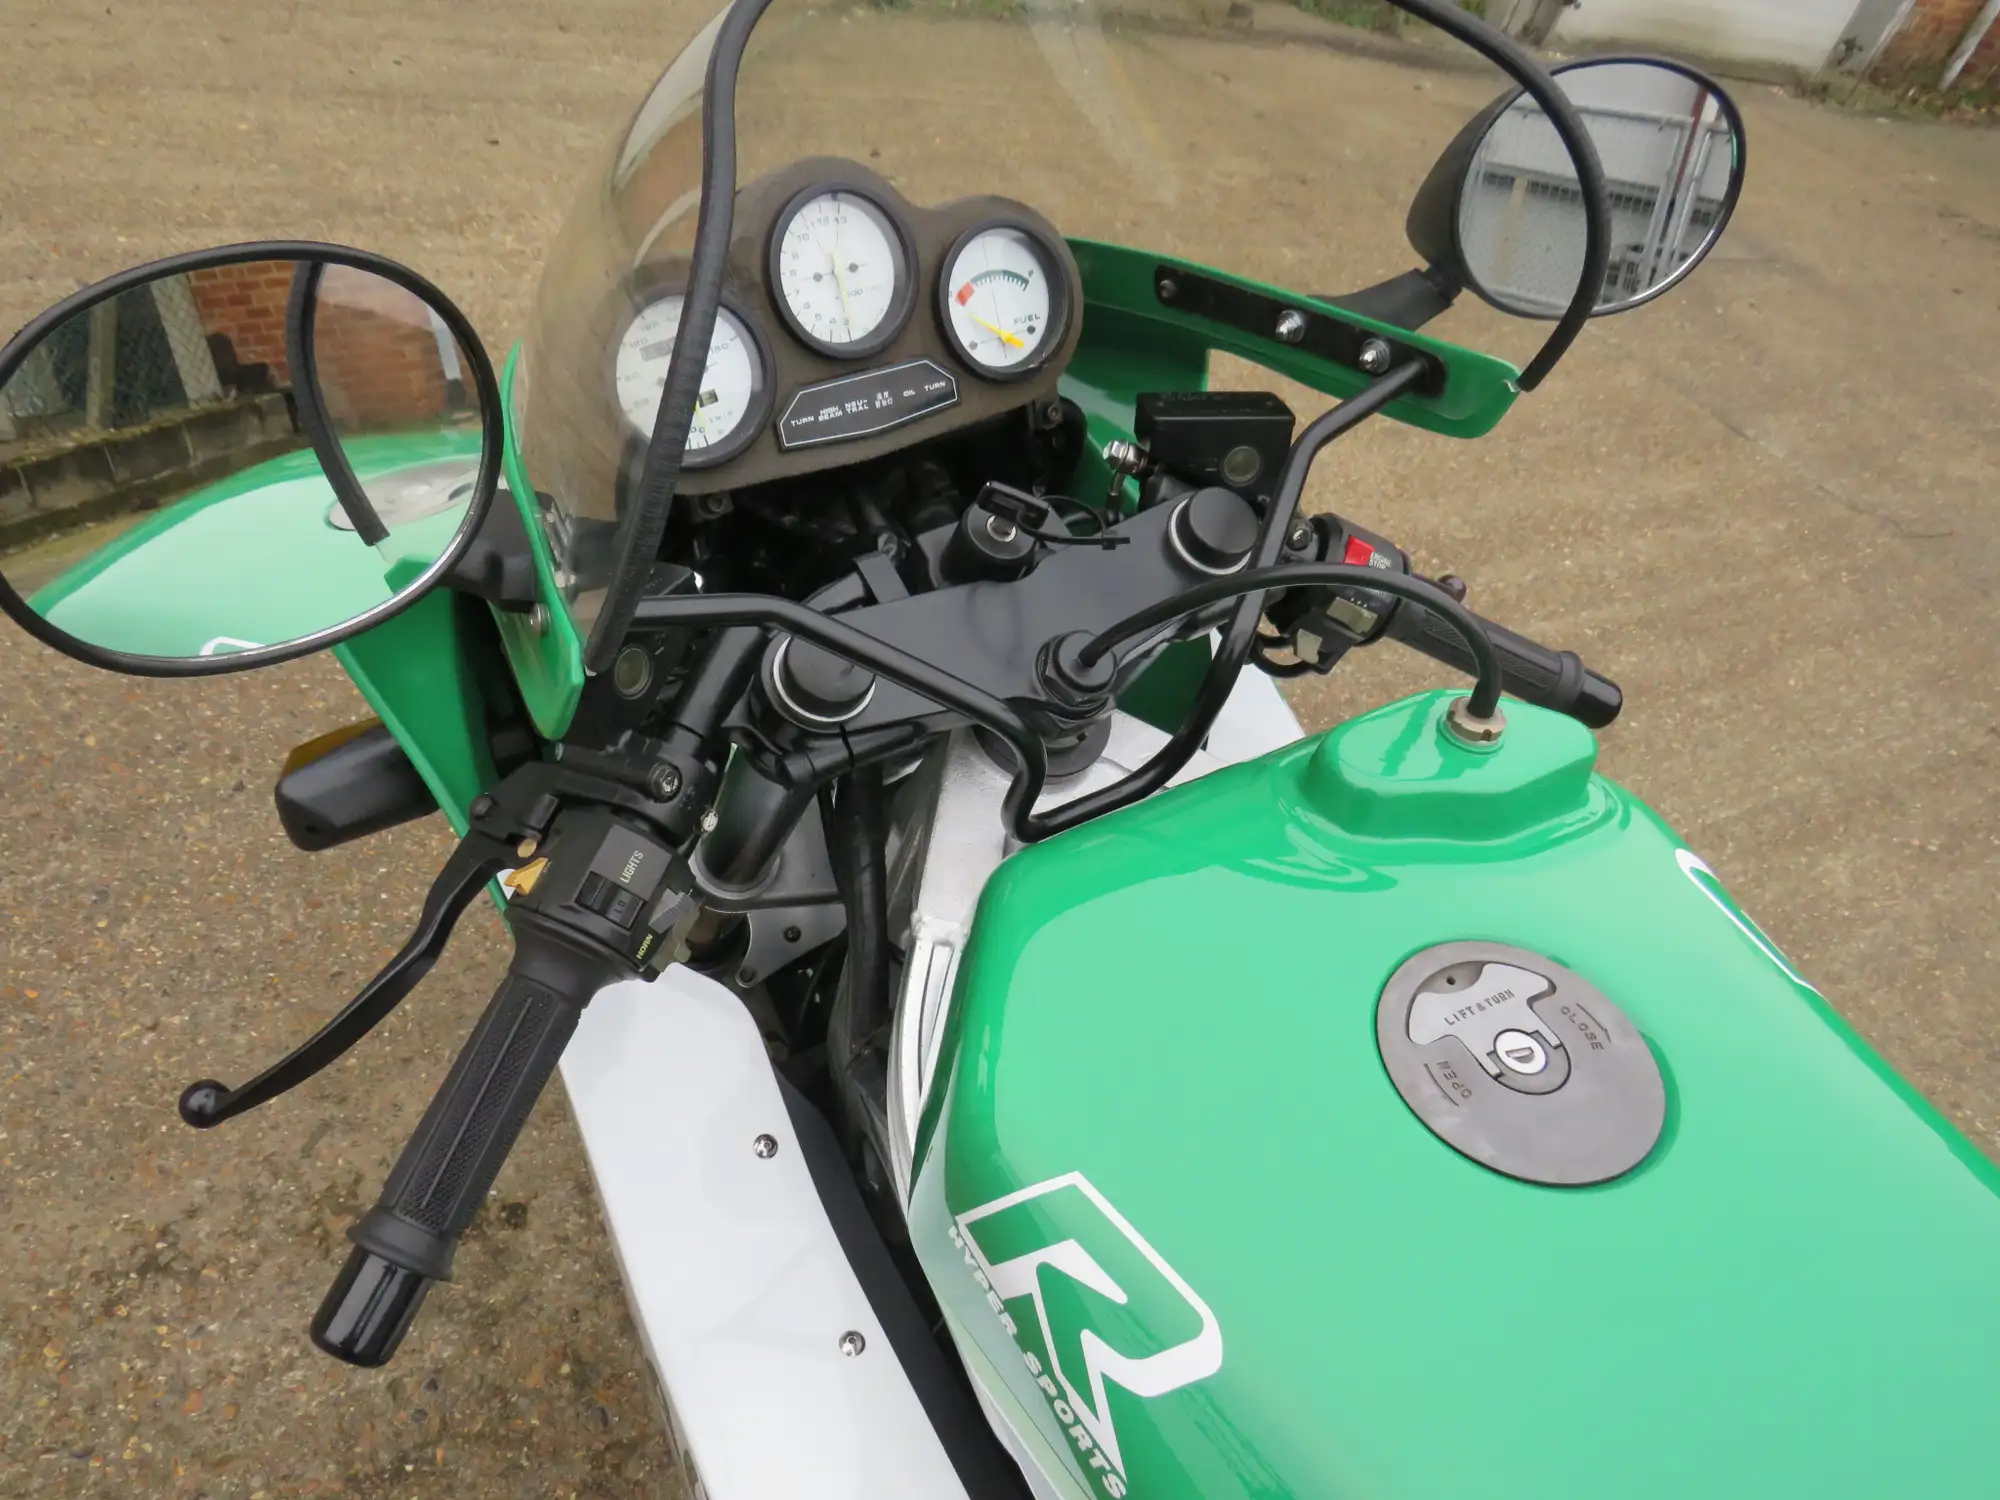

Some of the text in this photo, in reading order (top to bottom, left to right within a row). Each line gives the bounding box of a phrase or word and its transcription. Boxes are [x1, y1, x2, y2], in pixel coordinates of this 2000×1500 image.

[1013, 313, 1040, 325] FUEL
[903, 389, 915, 397] OIL
[924, 381, 946, 392] TURN
[818, 411, 843, 422] BEAM
[820, 405, 839, 416] HIGH
[790, 416, 814, 427] TURN
[620, 850, 643, 884] LIGHTS
[636, 933, 653, 960] HORN
[1444, 1004, 1476, 1027] LIFT
[1484, 988, 1516, 1007] TURN
[1560, 1005, 1604, 1051] CLOSE
[1436, 1059, 1473, 1101] OPEN
[1022, 1351, 1128, 1499] SPORTS
